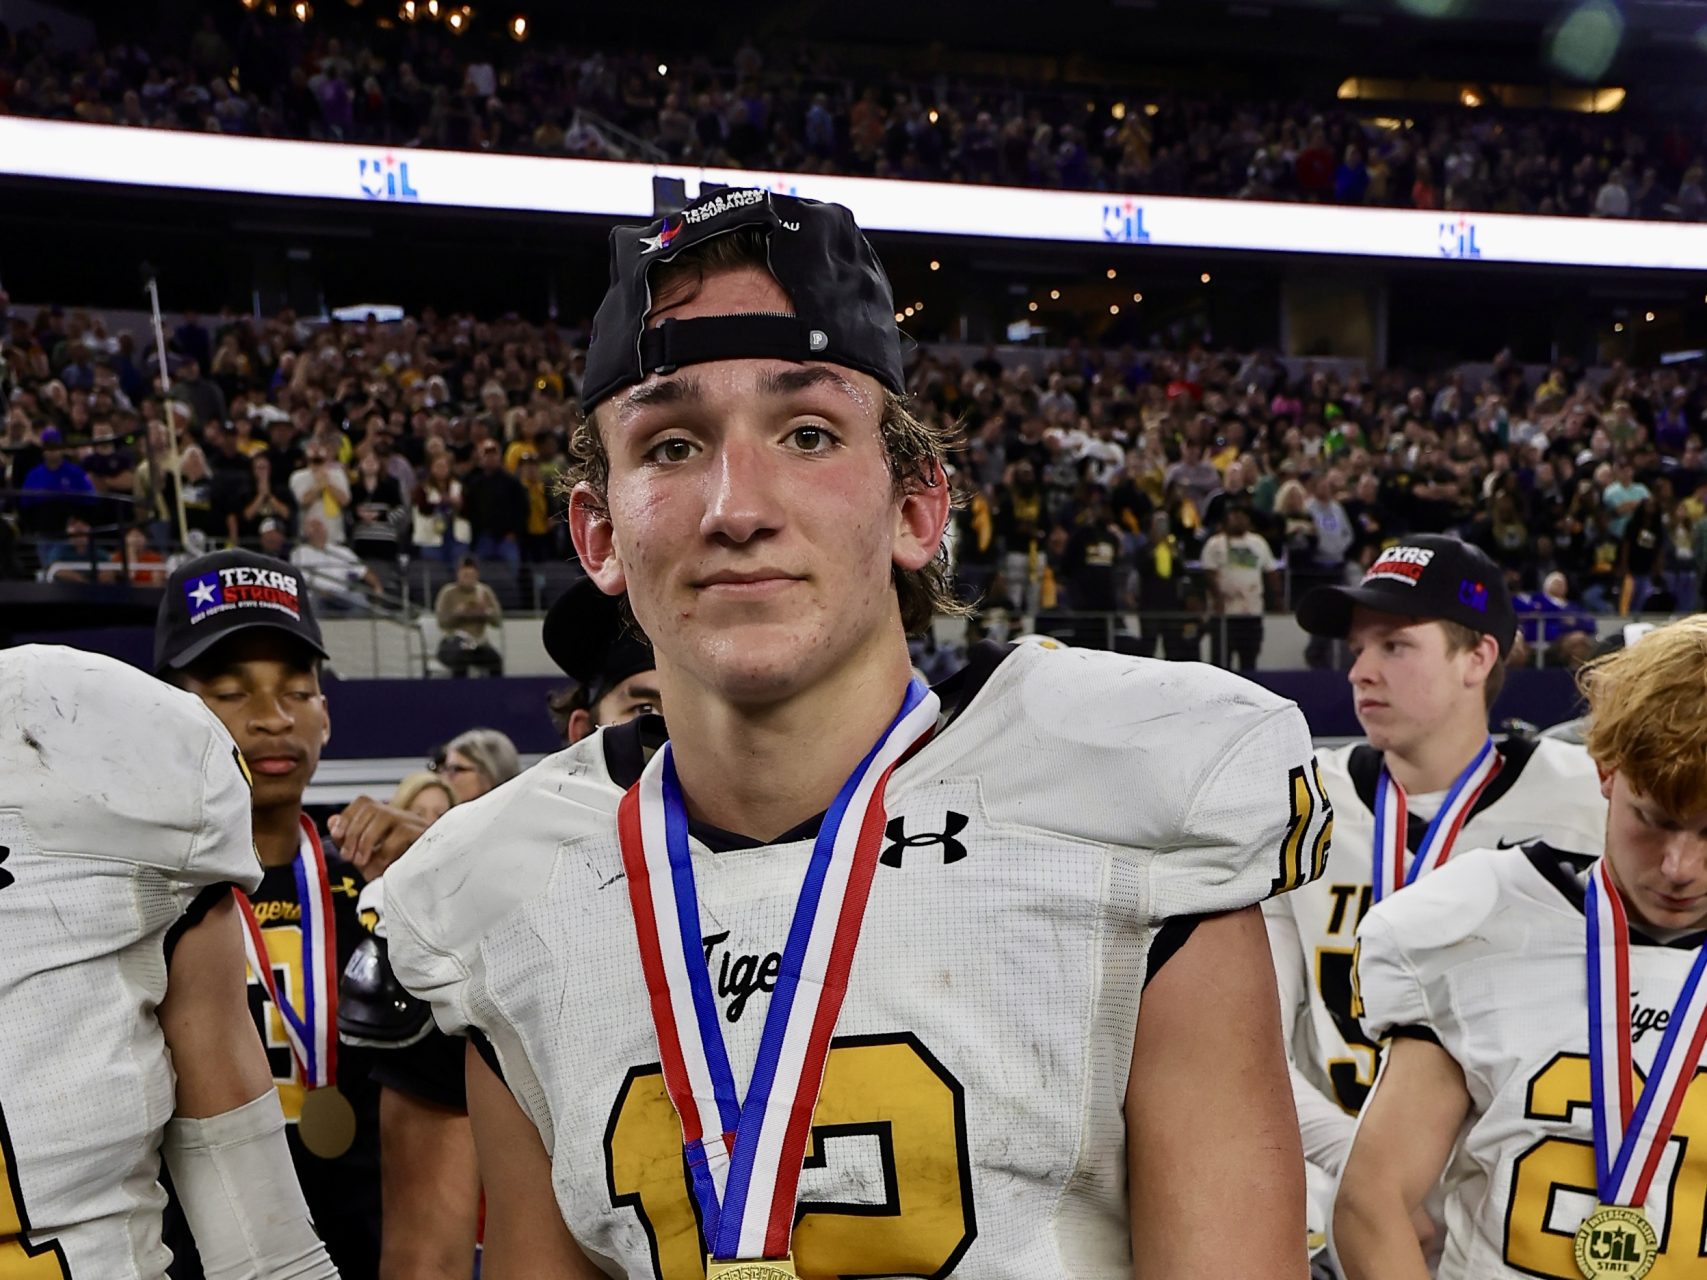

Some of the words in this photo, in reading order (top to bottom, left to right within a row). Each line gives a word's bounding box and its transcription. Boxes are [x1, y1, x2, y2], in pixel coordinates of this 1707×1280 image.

[681, 196, 725, 219] TEXAS
[218, 567, 298, 596] TEXAS
[702, 930, 784, 1024] Tige
[1597, 1261, 1629, 1273] STATE
